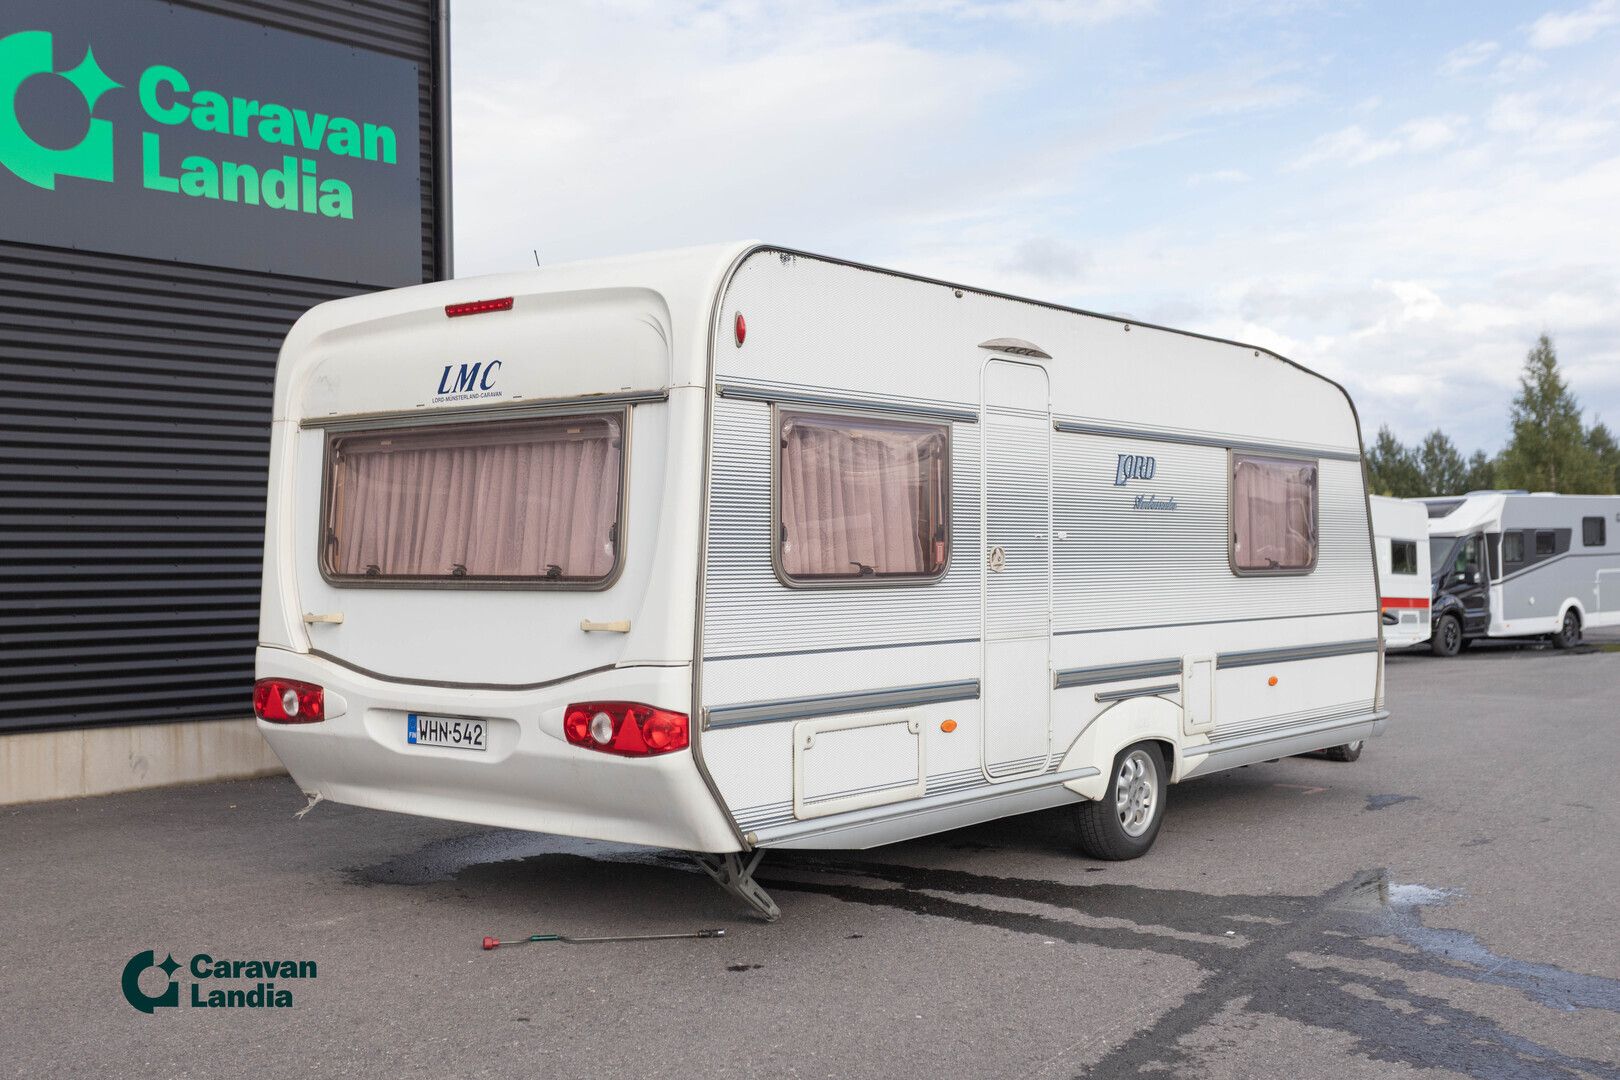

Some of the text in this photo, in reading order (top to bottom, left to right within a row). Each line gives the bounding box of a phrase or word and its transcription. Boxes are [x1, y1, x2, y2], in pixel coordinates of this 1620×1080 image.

[138, 64, 397, 165] Caravan
[142, 131, 354, 220] Landia
[437, 360, 502, 394] LMC
